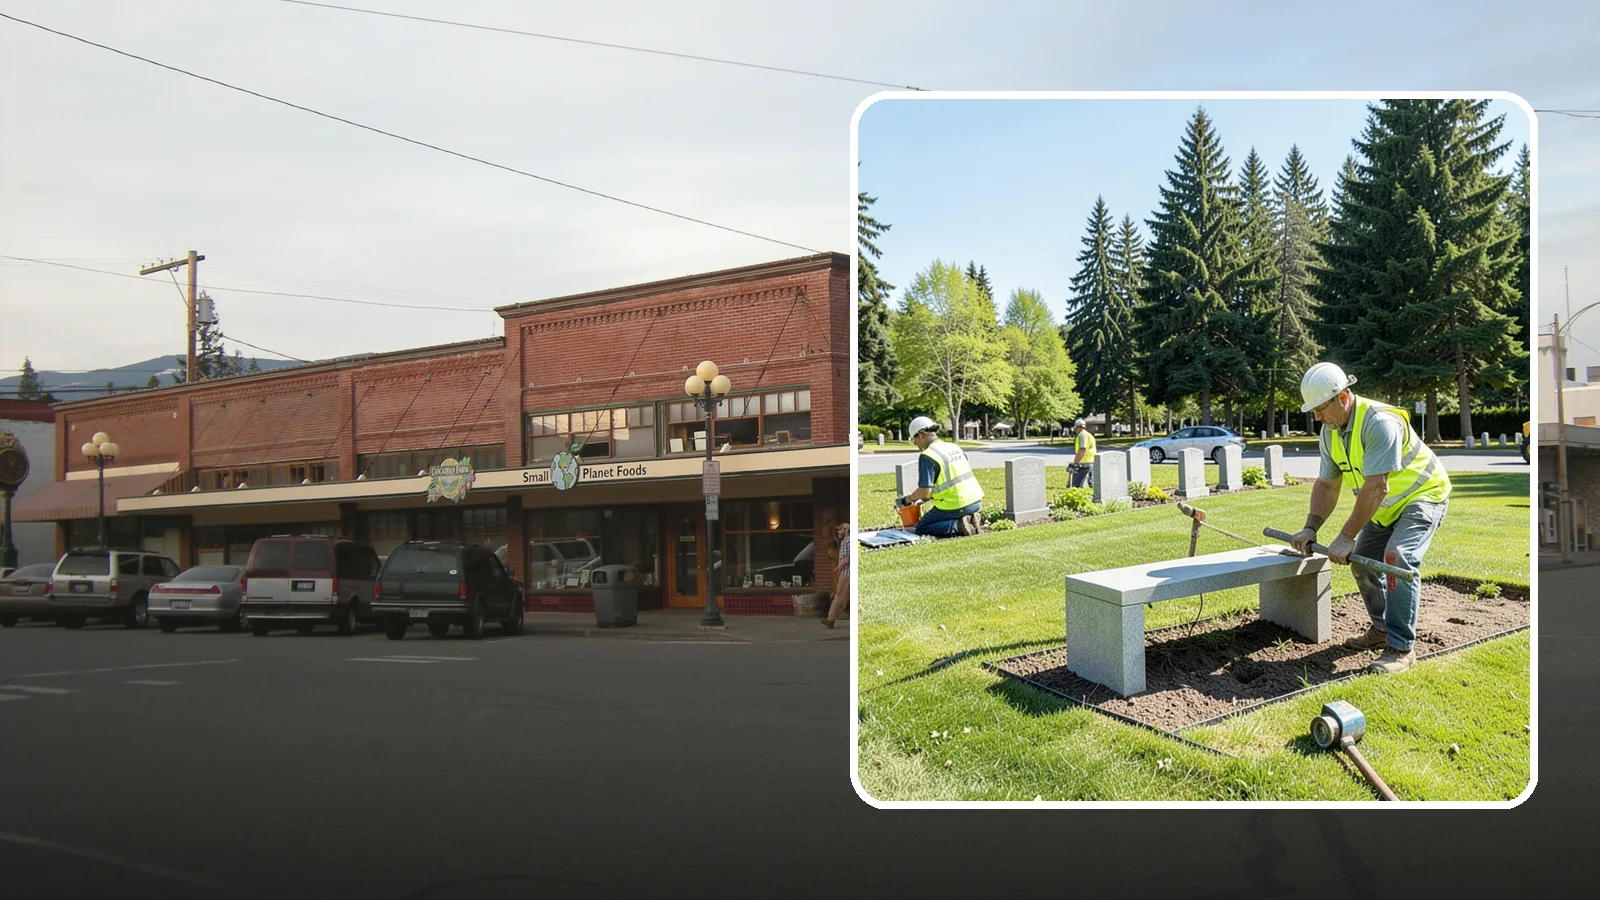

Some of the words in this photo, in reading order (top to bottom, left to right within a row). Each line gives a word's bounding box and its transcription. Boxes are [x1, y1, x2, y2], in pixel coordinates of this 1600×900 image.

[523, 471, 549, 483] Small
[582, 467, 614, 479] Planet
[616, 464, 647, 477] Foods
